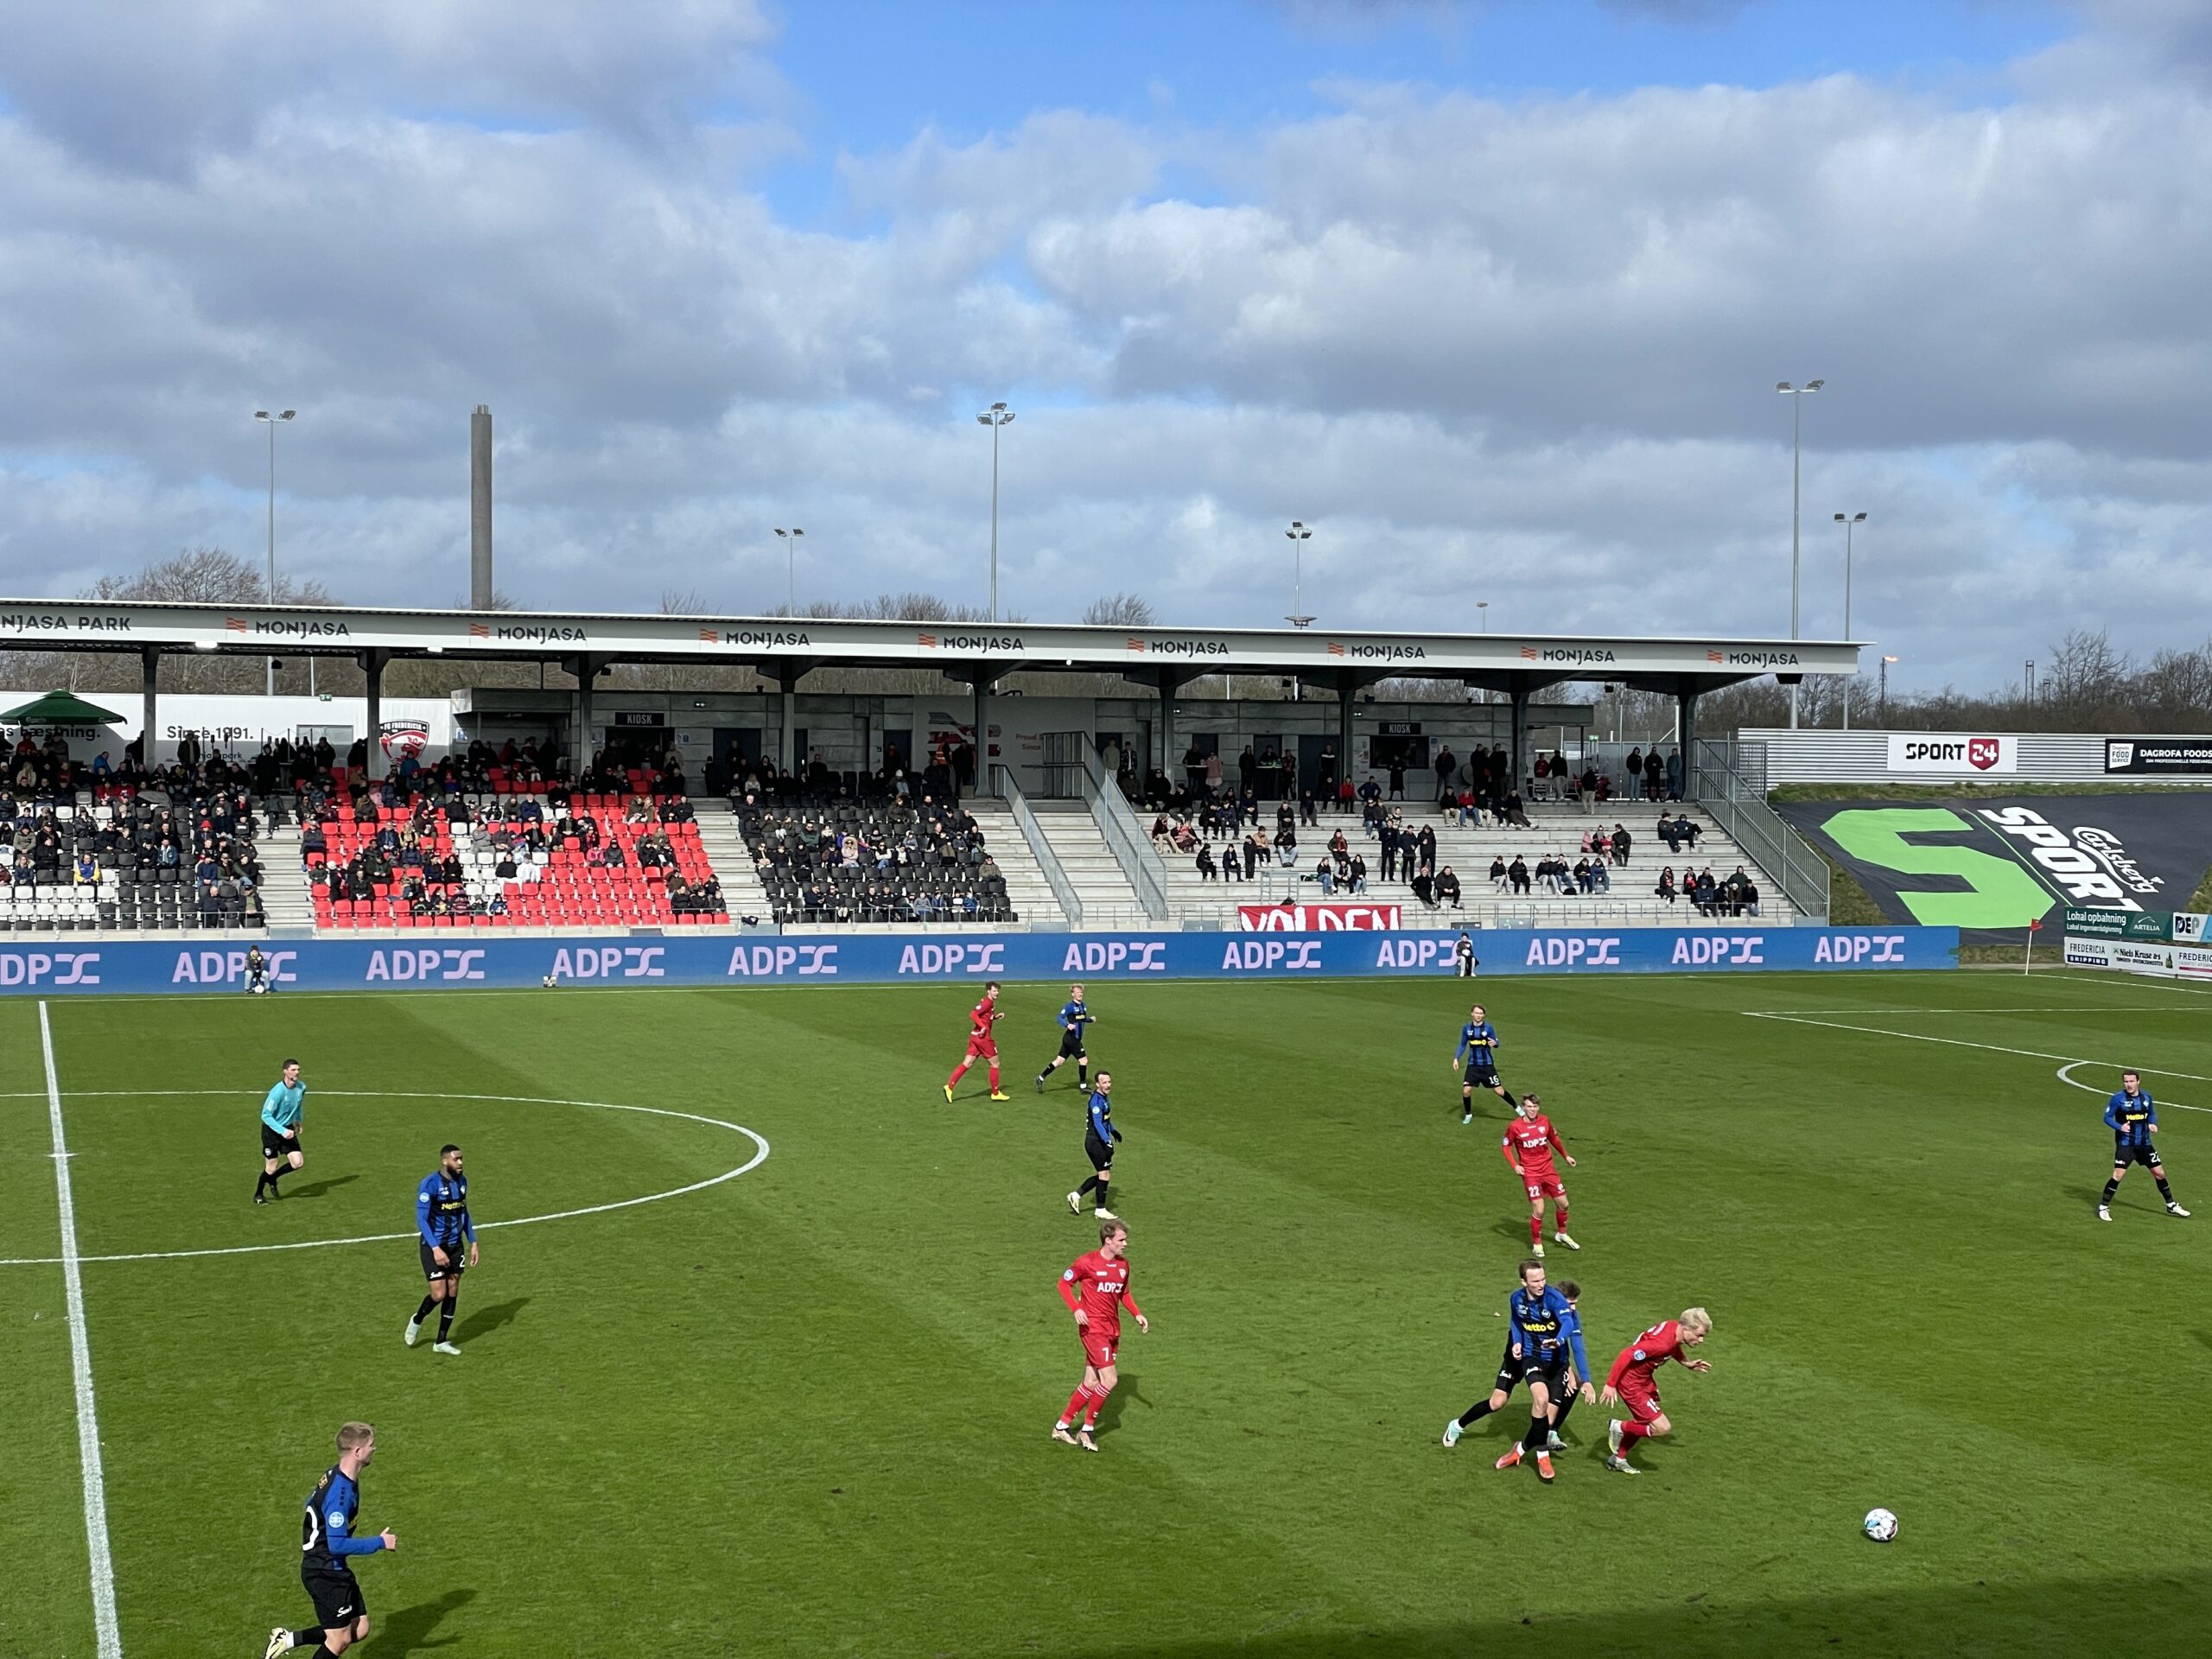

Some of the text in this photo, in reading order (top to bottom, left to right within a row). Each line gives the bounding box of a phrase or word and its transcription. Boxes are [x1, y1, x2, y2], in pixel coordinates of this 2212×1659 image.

[79, 616, 130, 631] PARK
[257, 621, 349, 639] MONJASA
[499, 626, 586, 643] MONJASA
[726, 631, 810, 648] MONJASA
[944, 635, 1025, 652] MONJASA
[1151, 639, 1230, 657] MONJASA
[1351, 645, 1426, 661] MONJASA
[1542, 648, 1615, 665] MONJASA
[1729, 652, 1799, 668] MONJASA
[391, 721, 422, 730] FREDERICIA
[626, 714, 652, 724] KIOSK
[1389, 724, 1411, 734] KIOSK
[1906, 743, 1998, 761] SPORT 24
[2140, 749, 2182, 758] DAGROFA
[1977, 806, 2144, 912] SPORT
[2073, 826, 2160, 893] Carlsberg
[2067, 911, 2126, 926] Lokal opbakning
[2070, 944, 2106, 954] FREDERICIA
[2120, 949, 2134, 957] Niels
[2134, 950, 2152, 959] Kruse
[2069, 956, 2106, 965] SHIPPING
[1529, 1185, 1540, 1198] 22
